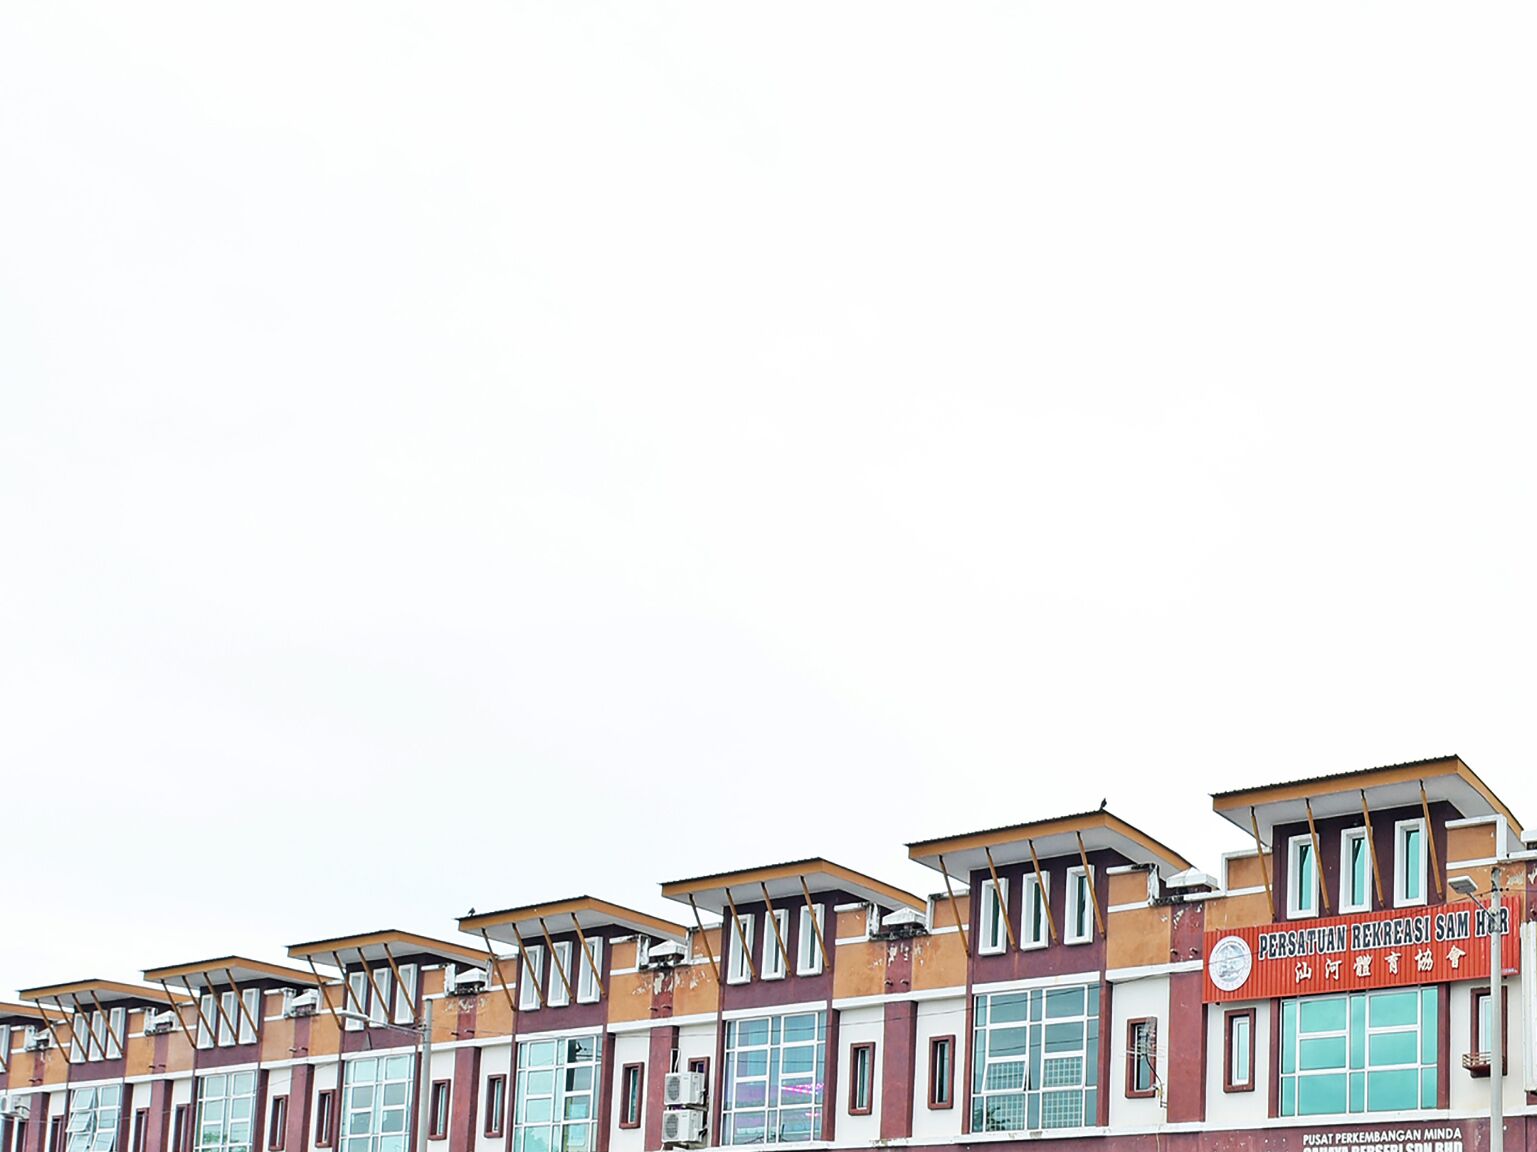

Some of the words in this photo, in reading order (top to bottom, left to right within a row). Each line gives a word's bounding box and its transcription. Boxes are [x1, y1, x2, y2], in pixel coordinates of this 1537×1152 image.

[1259, 925, 1346, 960] PERSATUAN
[1351, 914, 1431, 951] REKREASI
[1435, 911, 1470, 942] SAM
[1303, 1133, 1334, 1146] PUSAT
[1335, 1129, 1419, 1144] PERKEMBANGAN
[1424, 1128, 1462, 1140] MINDA
